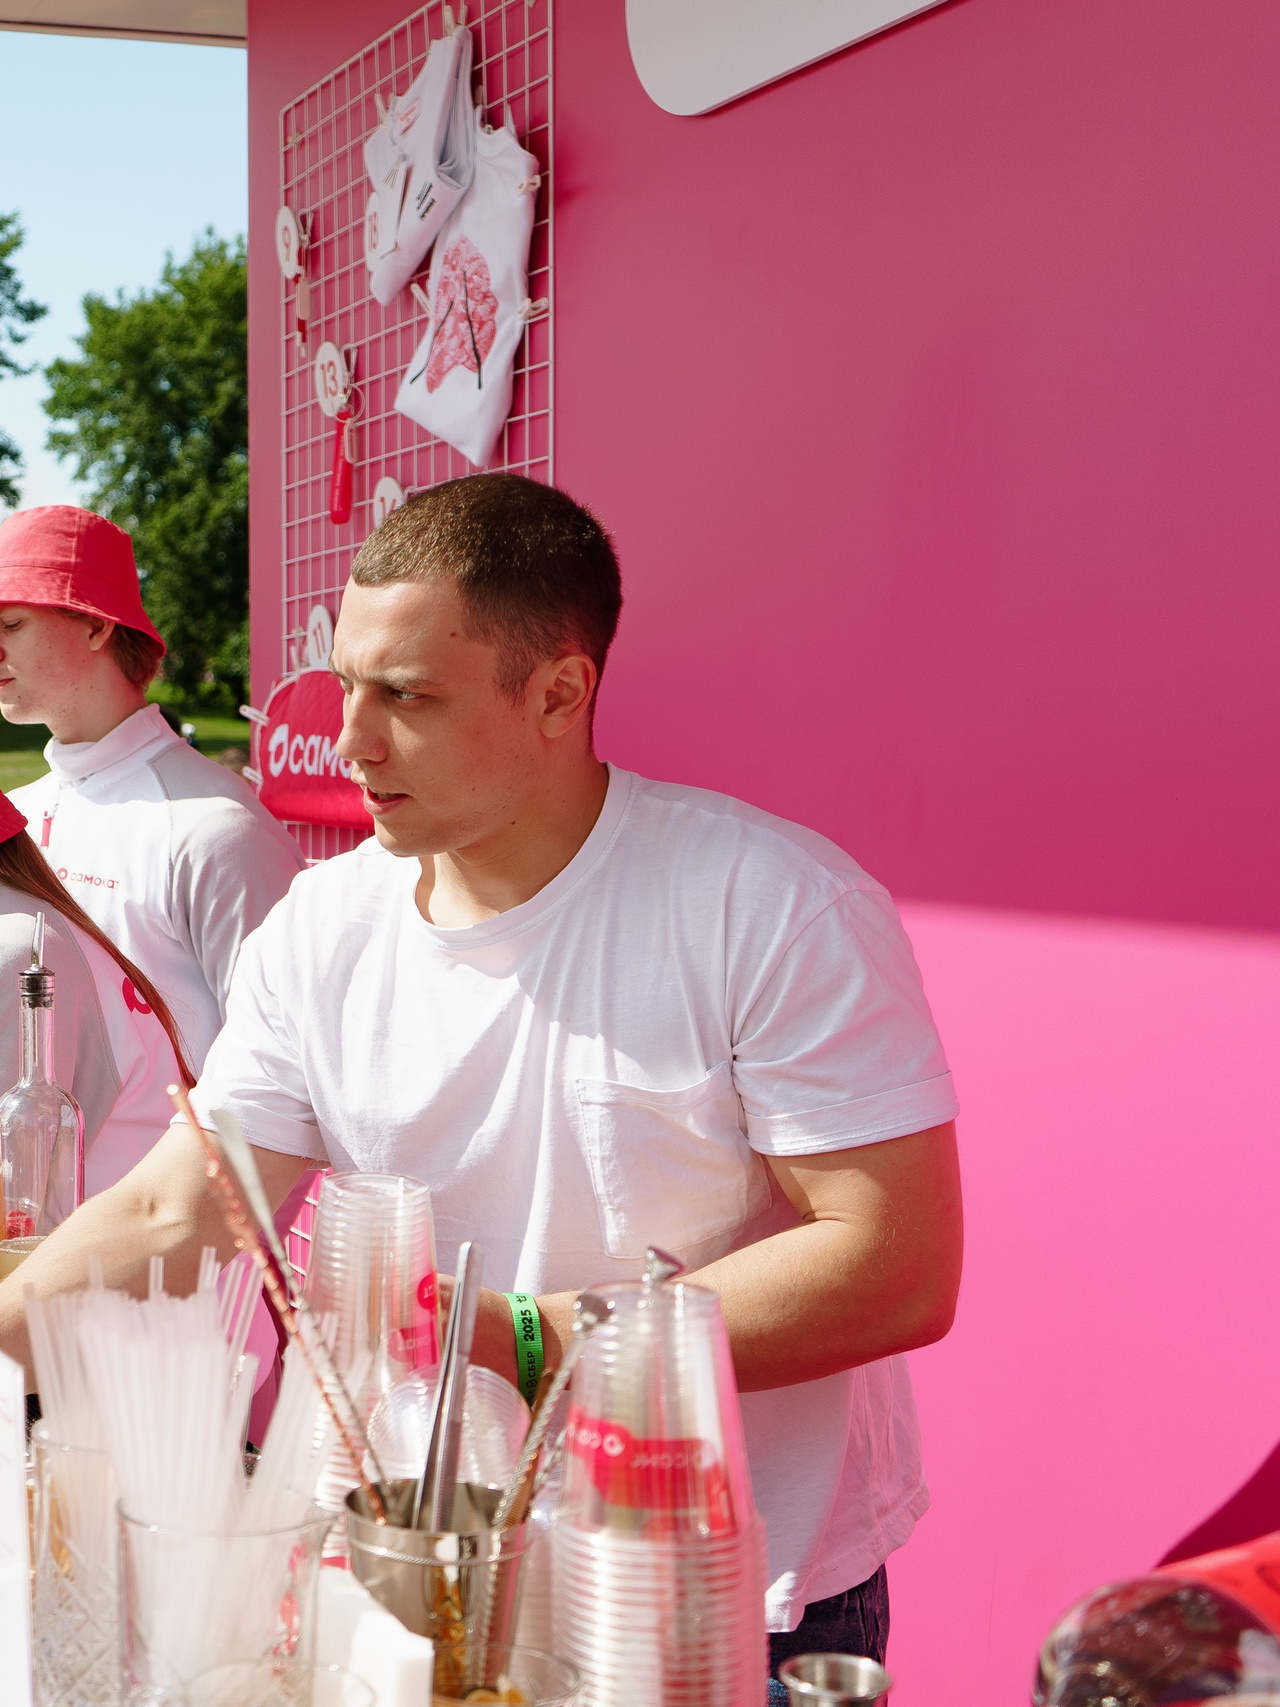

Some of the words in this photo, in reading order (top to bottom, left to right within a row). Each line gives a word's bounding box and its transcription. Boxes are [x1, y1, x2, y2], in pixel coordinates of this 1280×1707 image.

[320, 360, 339, 399] 13
[520, 1309, 535, 1342] 2025
[526, 1351, 537, 1378] СБЕР
